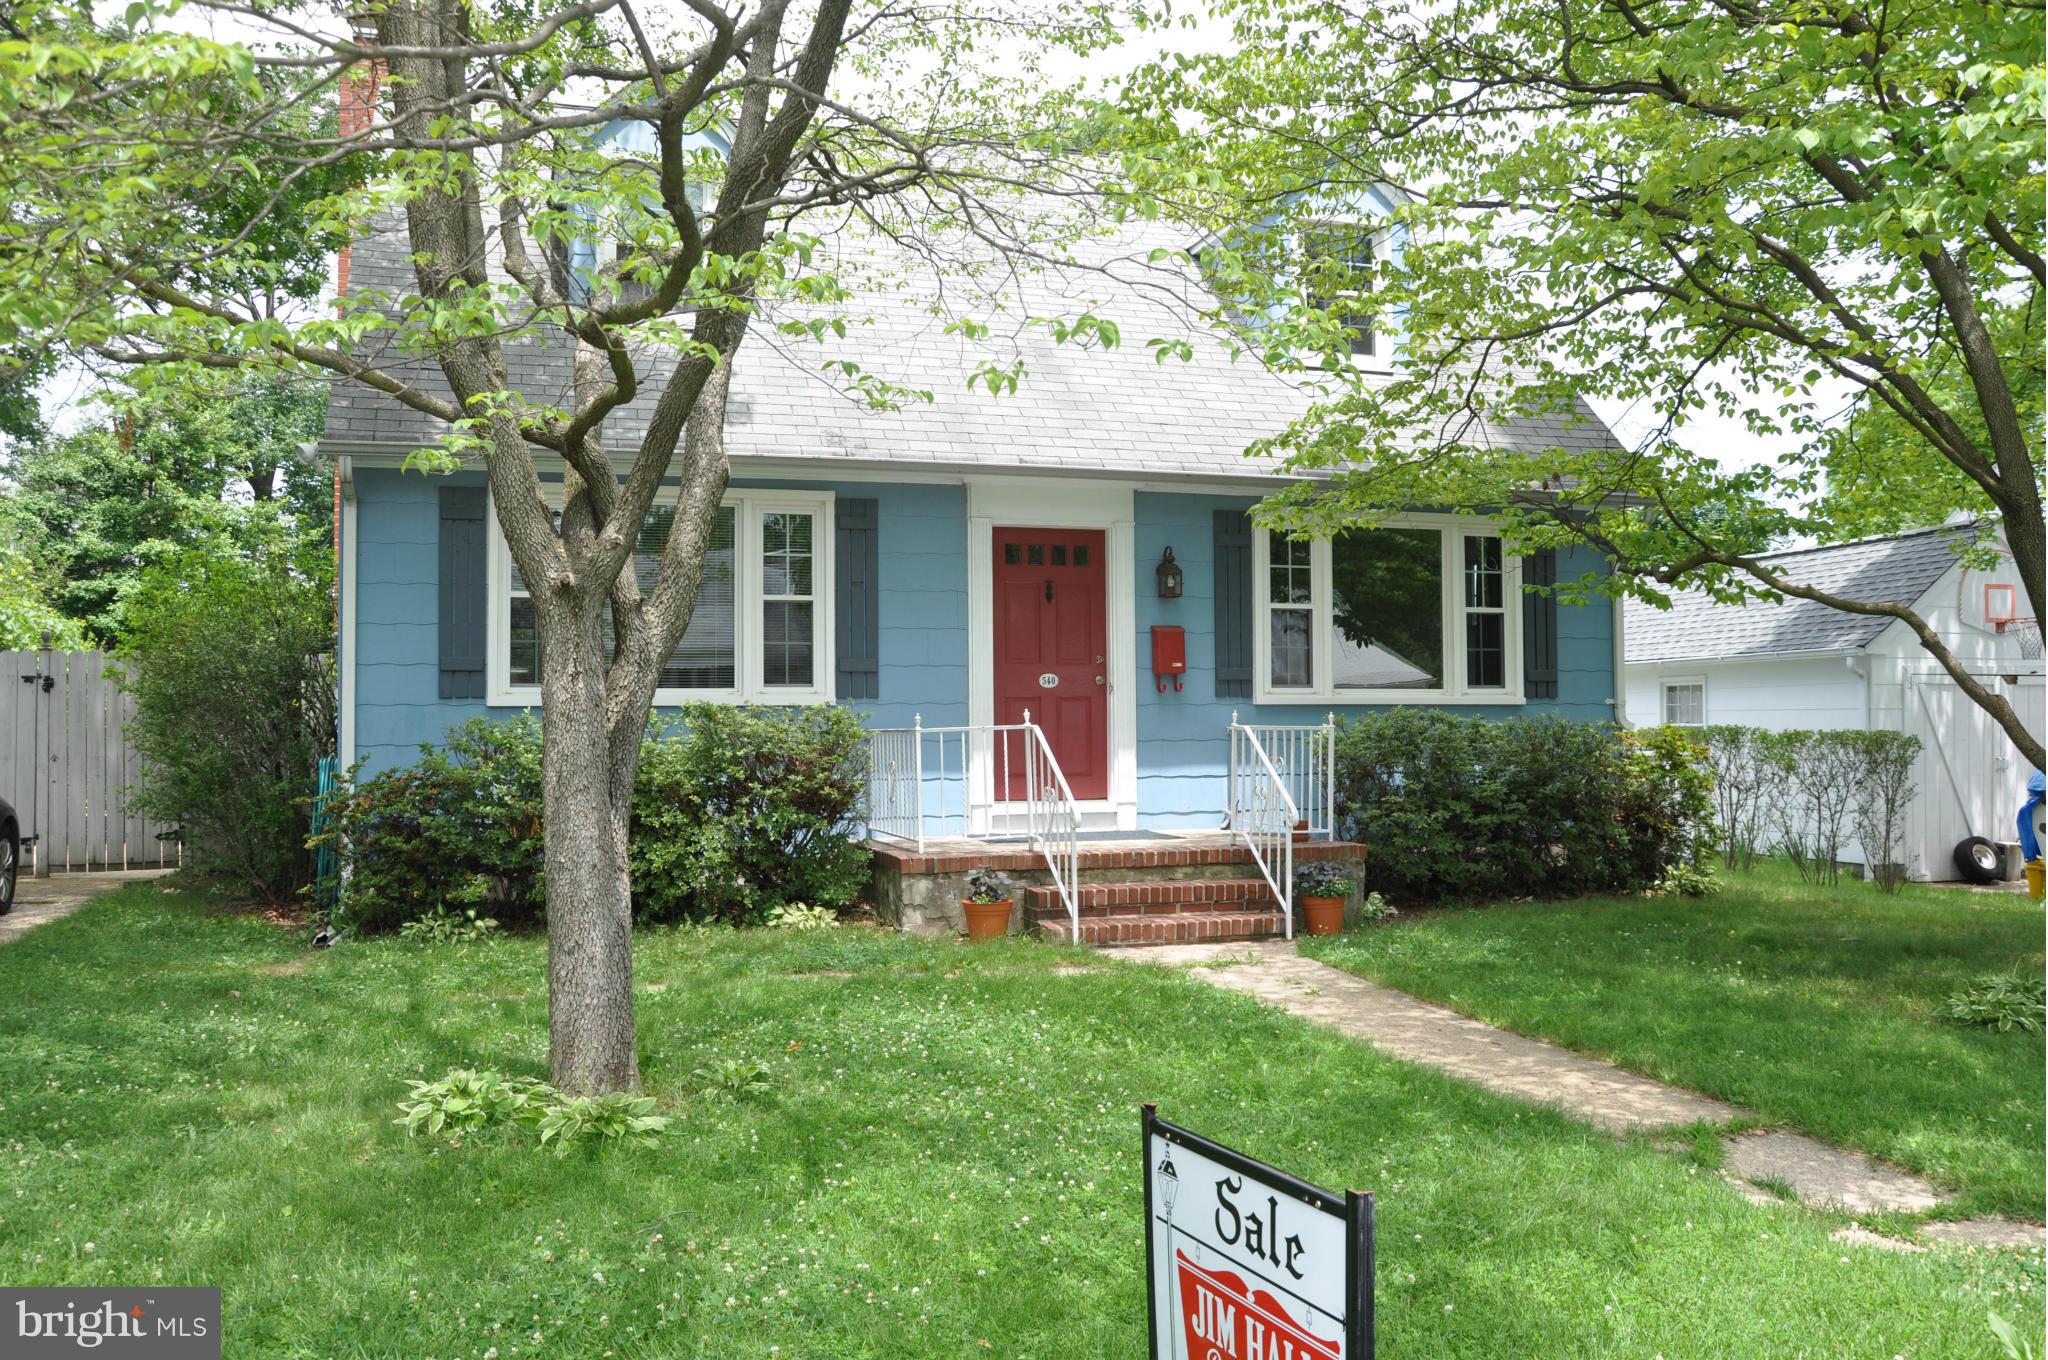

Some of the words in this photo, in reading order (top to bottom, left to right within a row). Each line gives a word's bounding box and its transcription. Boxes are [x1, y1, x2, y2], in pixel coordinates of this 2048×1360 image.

[1041, 676, 1056, 685] 540
[1214, 1175, 1306, 1281] Sale
[1191, 1283, 1238, 1359] JIM
[1245, 1314, 1313, 1360] HA
